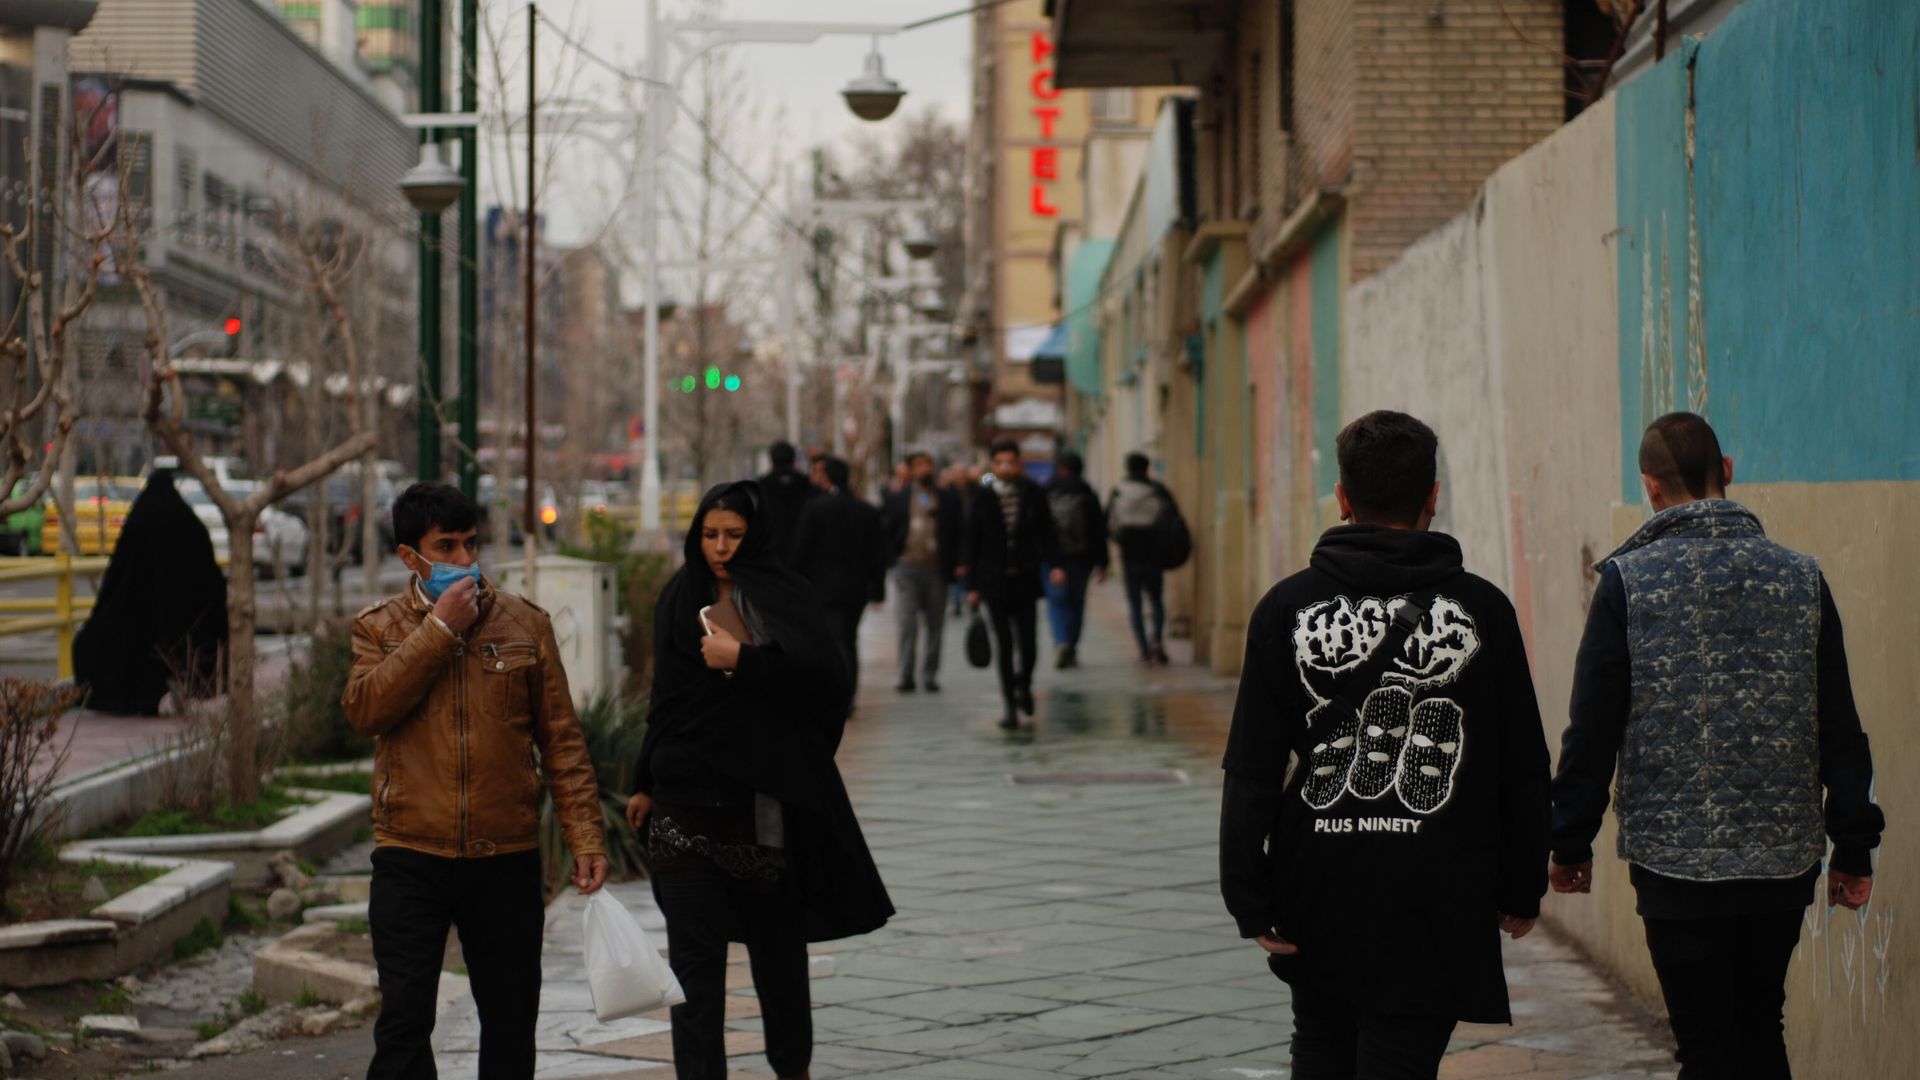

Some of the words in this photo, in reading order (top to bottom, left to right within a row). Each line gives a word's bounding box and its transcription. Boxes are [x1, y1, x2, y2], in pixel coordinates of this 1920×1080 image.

[1030, 32, 1063, 217] HOTEL
[1314, 818, 1353, 833] PLUS
[1358, 817, 1422, 833] NINETY
